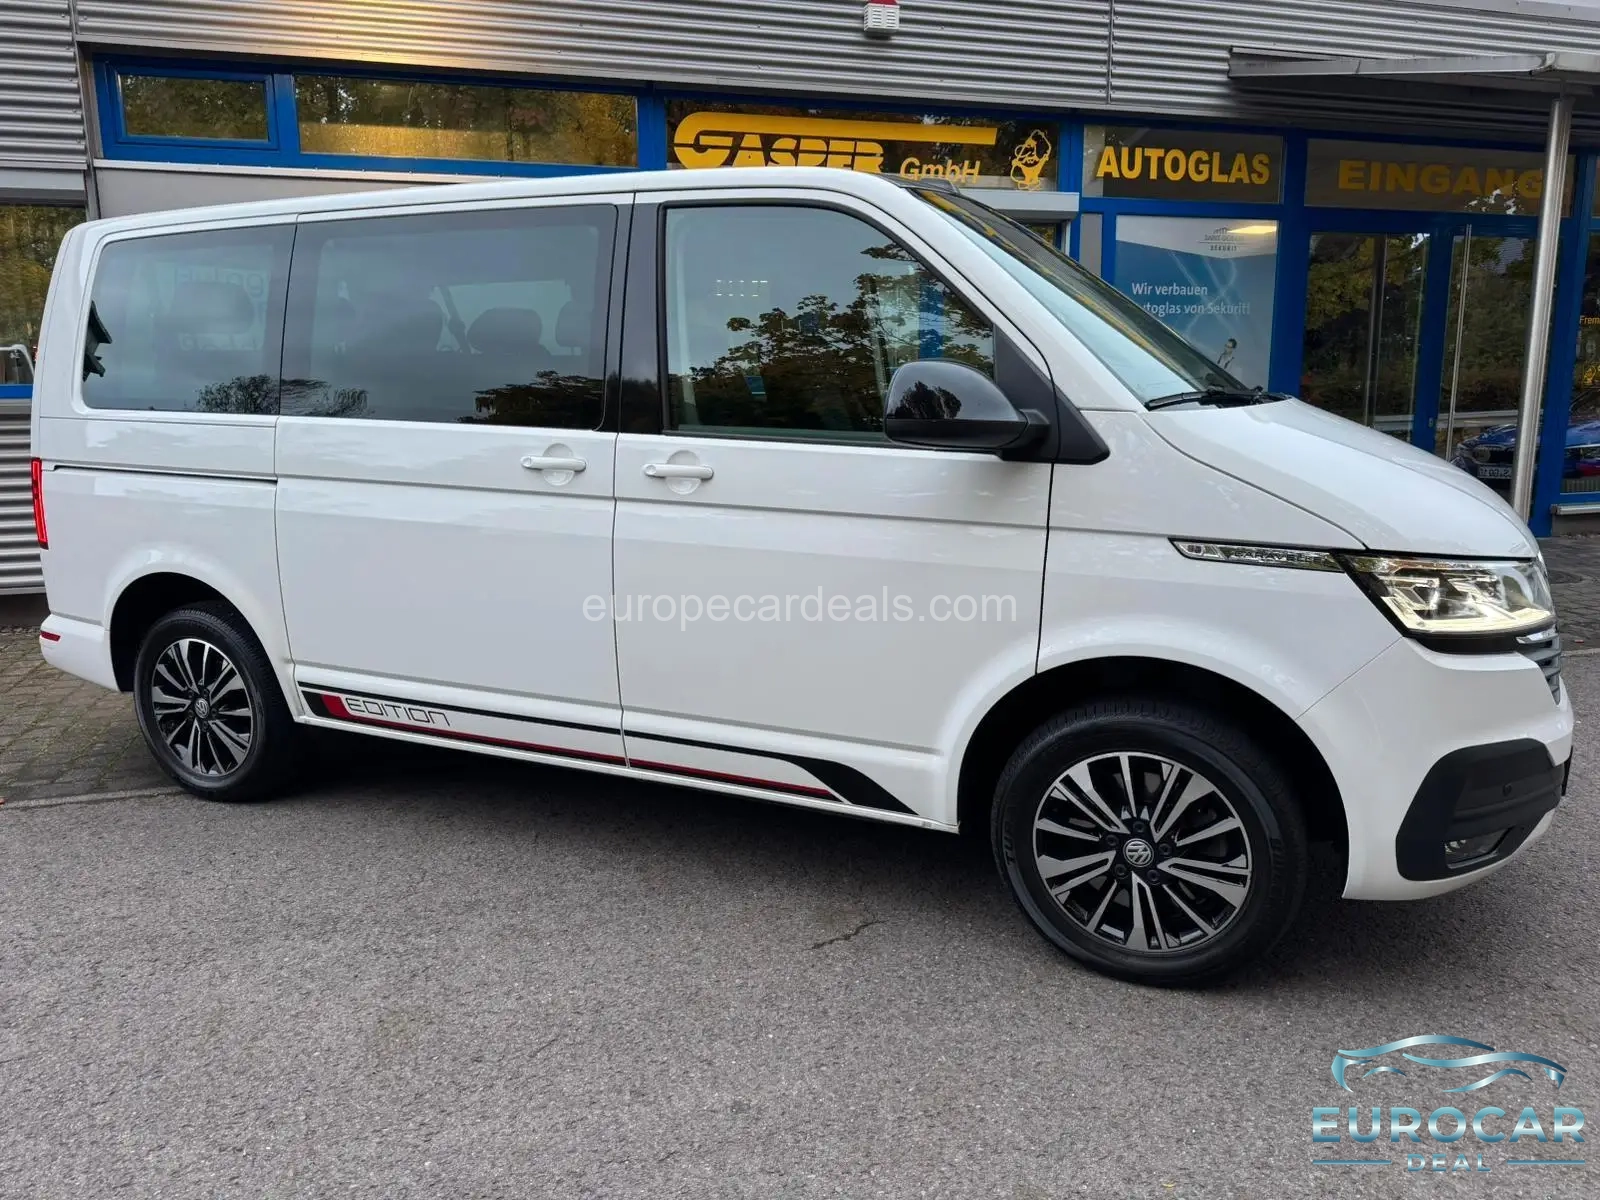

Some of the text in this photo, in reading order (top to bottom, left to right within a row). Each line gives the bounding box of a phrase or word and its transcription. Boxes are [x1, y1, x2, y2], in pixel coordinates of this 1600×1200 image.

[673, 112, 997, 184] GASPER GmbH
[1096, 146, 1270, 185] AUTOGLAS
[1338, 159, 1544, 199] EINGANG
[1132, 282, 1208, 296] Wir verbauen
[1141, 302, 1181, 317] toglas
[1184, 304, 1204, 314] von
[345, 697, 451, 726] EDITION
